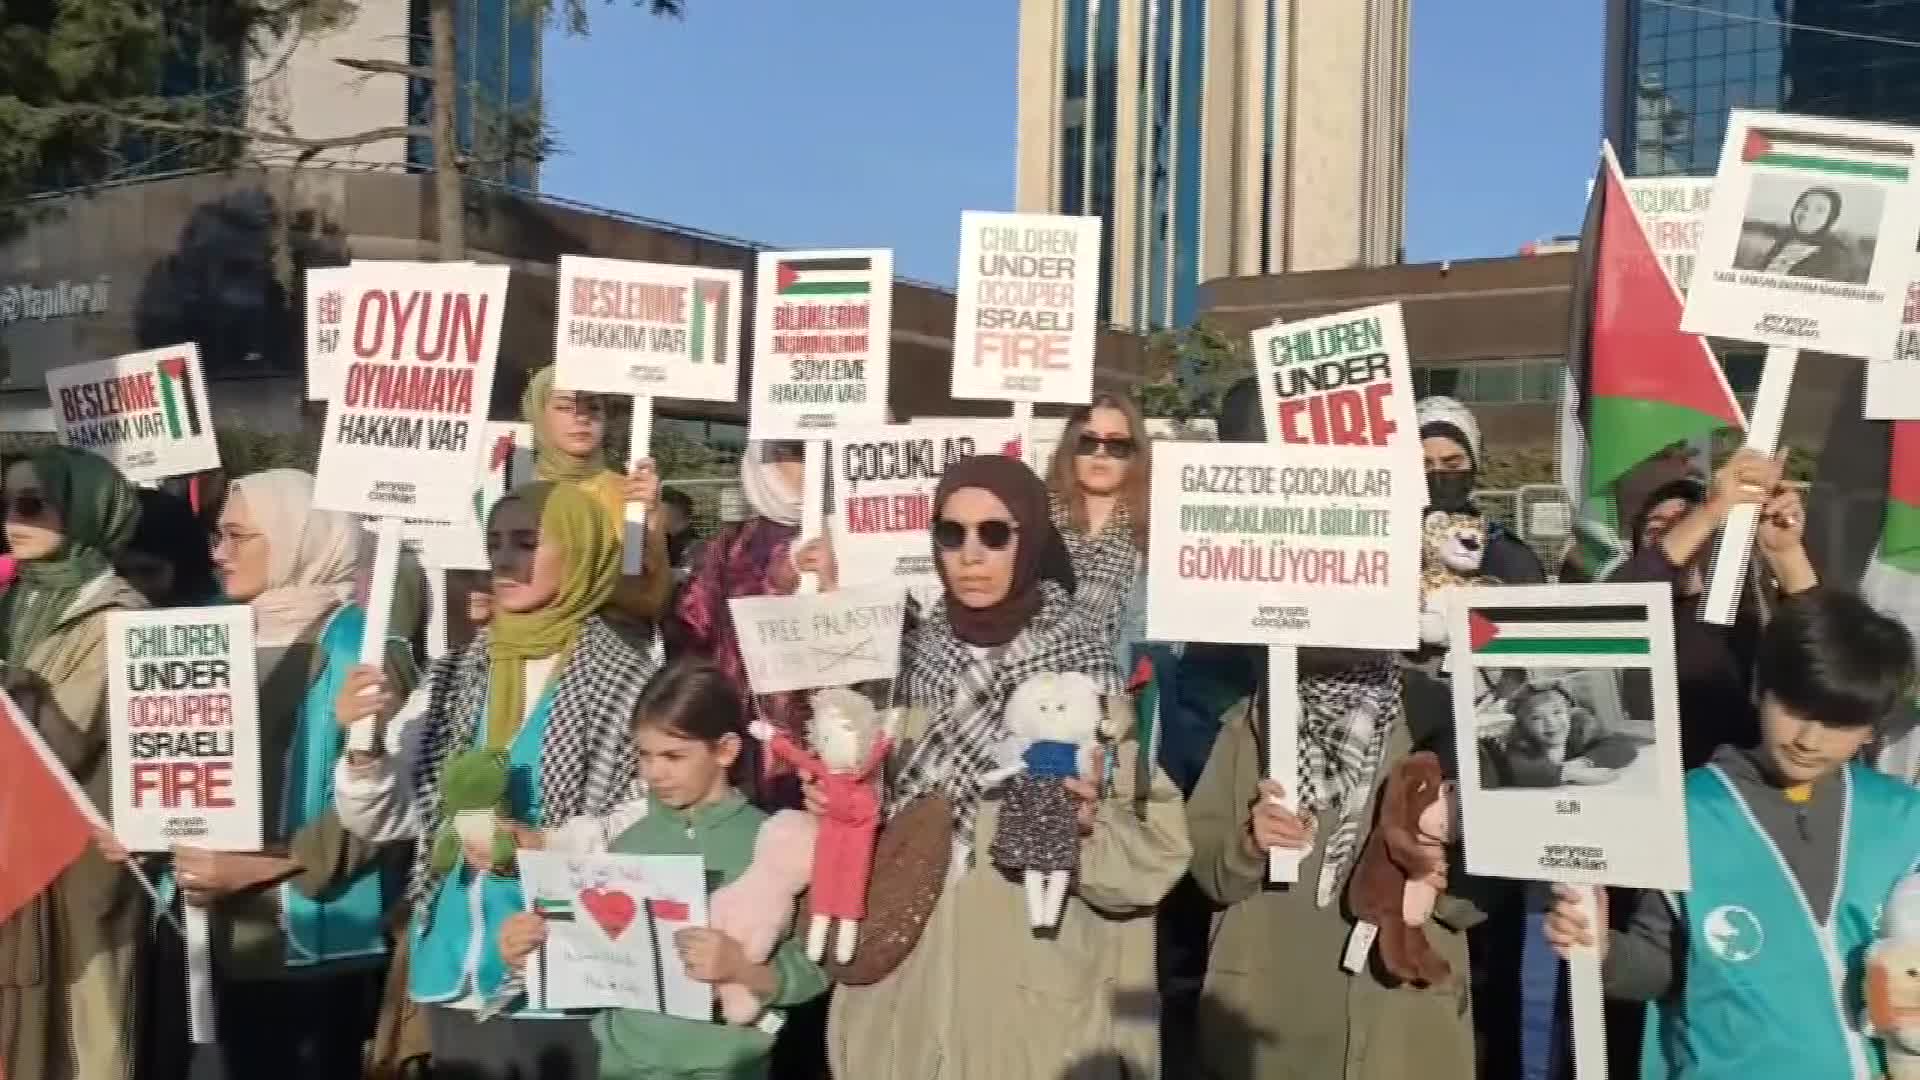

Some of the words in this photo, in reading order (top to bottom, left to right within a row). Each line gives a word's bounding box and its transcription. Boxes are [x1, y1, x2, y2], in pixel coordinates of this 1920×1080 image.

[980, 226, 1077, 254] CHILDREN
[979, 254, 1075, 279] UNDER
[572, 277, 688, 324] BESLENME
[978, 279, 1075, 307] OCCUPIER
[353, 289, 488, 363] OYUN
[568, 319, 646, 350] HAKKIM
[649, 326, 687, 353] VAR
[976, 308, 1073, 332] ISRAELI
[974, 332, 1071, 370] FIRE
[1269, 317, 1382, 367] CHILDREN
[344, 363, 474, 413] OYNAMAYA
[769, 384, 833, 403] HAKKIM
[837, 384, 866, 402] VAR
[1273, 353, 1391, 398] UNDER
[59, 372, 159, 423] BESLENME
[66, 418, 131, 448] HAKKIM
[135, 412, 166, 440] VAR
[337, 414, 422, 449] HAKKIM
[427, 419, 469, 451] VAR
[1182, 464, 1276, 495] GAZZE'DE
[1280, 466, 1391, 501] ÇOCUKLAR
[1180, 503, 1317, 534] OYUNCAKLARIYLA
[1320, 503, 1391, 538] BİRLİKTE
[1178, 537, 1390, 586] GÖMÜLÜYORLAR
[127, 624, 230, 657] CHILDREN
[127, 660, 231, 690] UNDER
[128, 694, 232, 727] OCCUPIER
[130, 731, 234, 758] ISRAELI
[131, 762, 235, 808] FIRE
